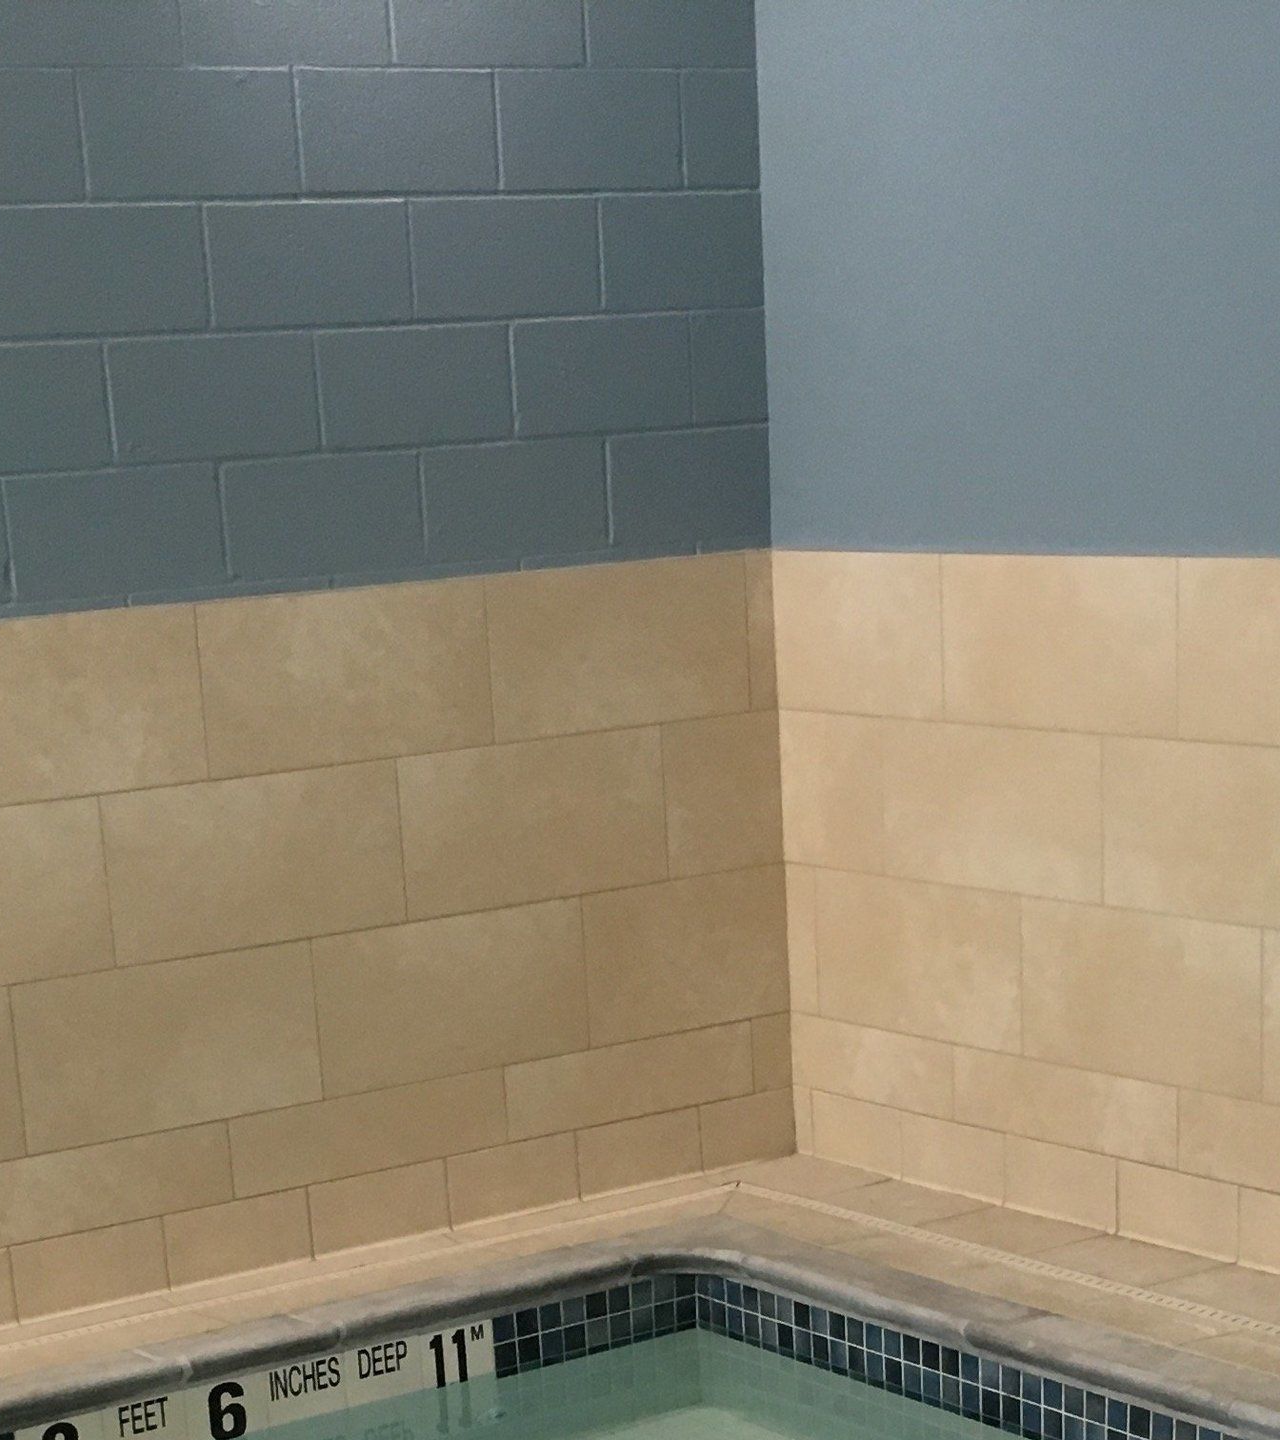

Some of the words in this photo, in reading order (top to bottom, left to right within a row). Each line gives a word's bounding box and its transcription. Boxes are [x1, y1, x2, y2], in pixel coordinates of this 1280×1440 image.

[118, 1397, 169, 1438] FEET
[208, 1381, 247, 1440] 6
[269, 1356, 341, 1402] INCHES
[358, 1341, 408, 1380] DEEP
